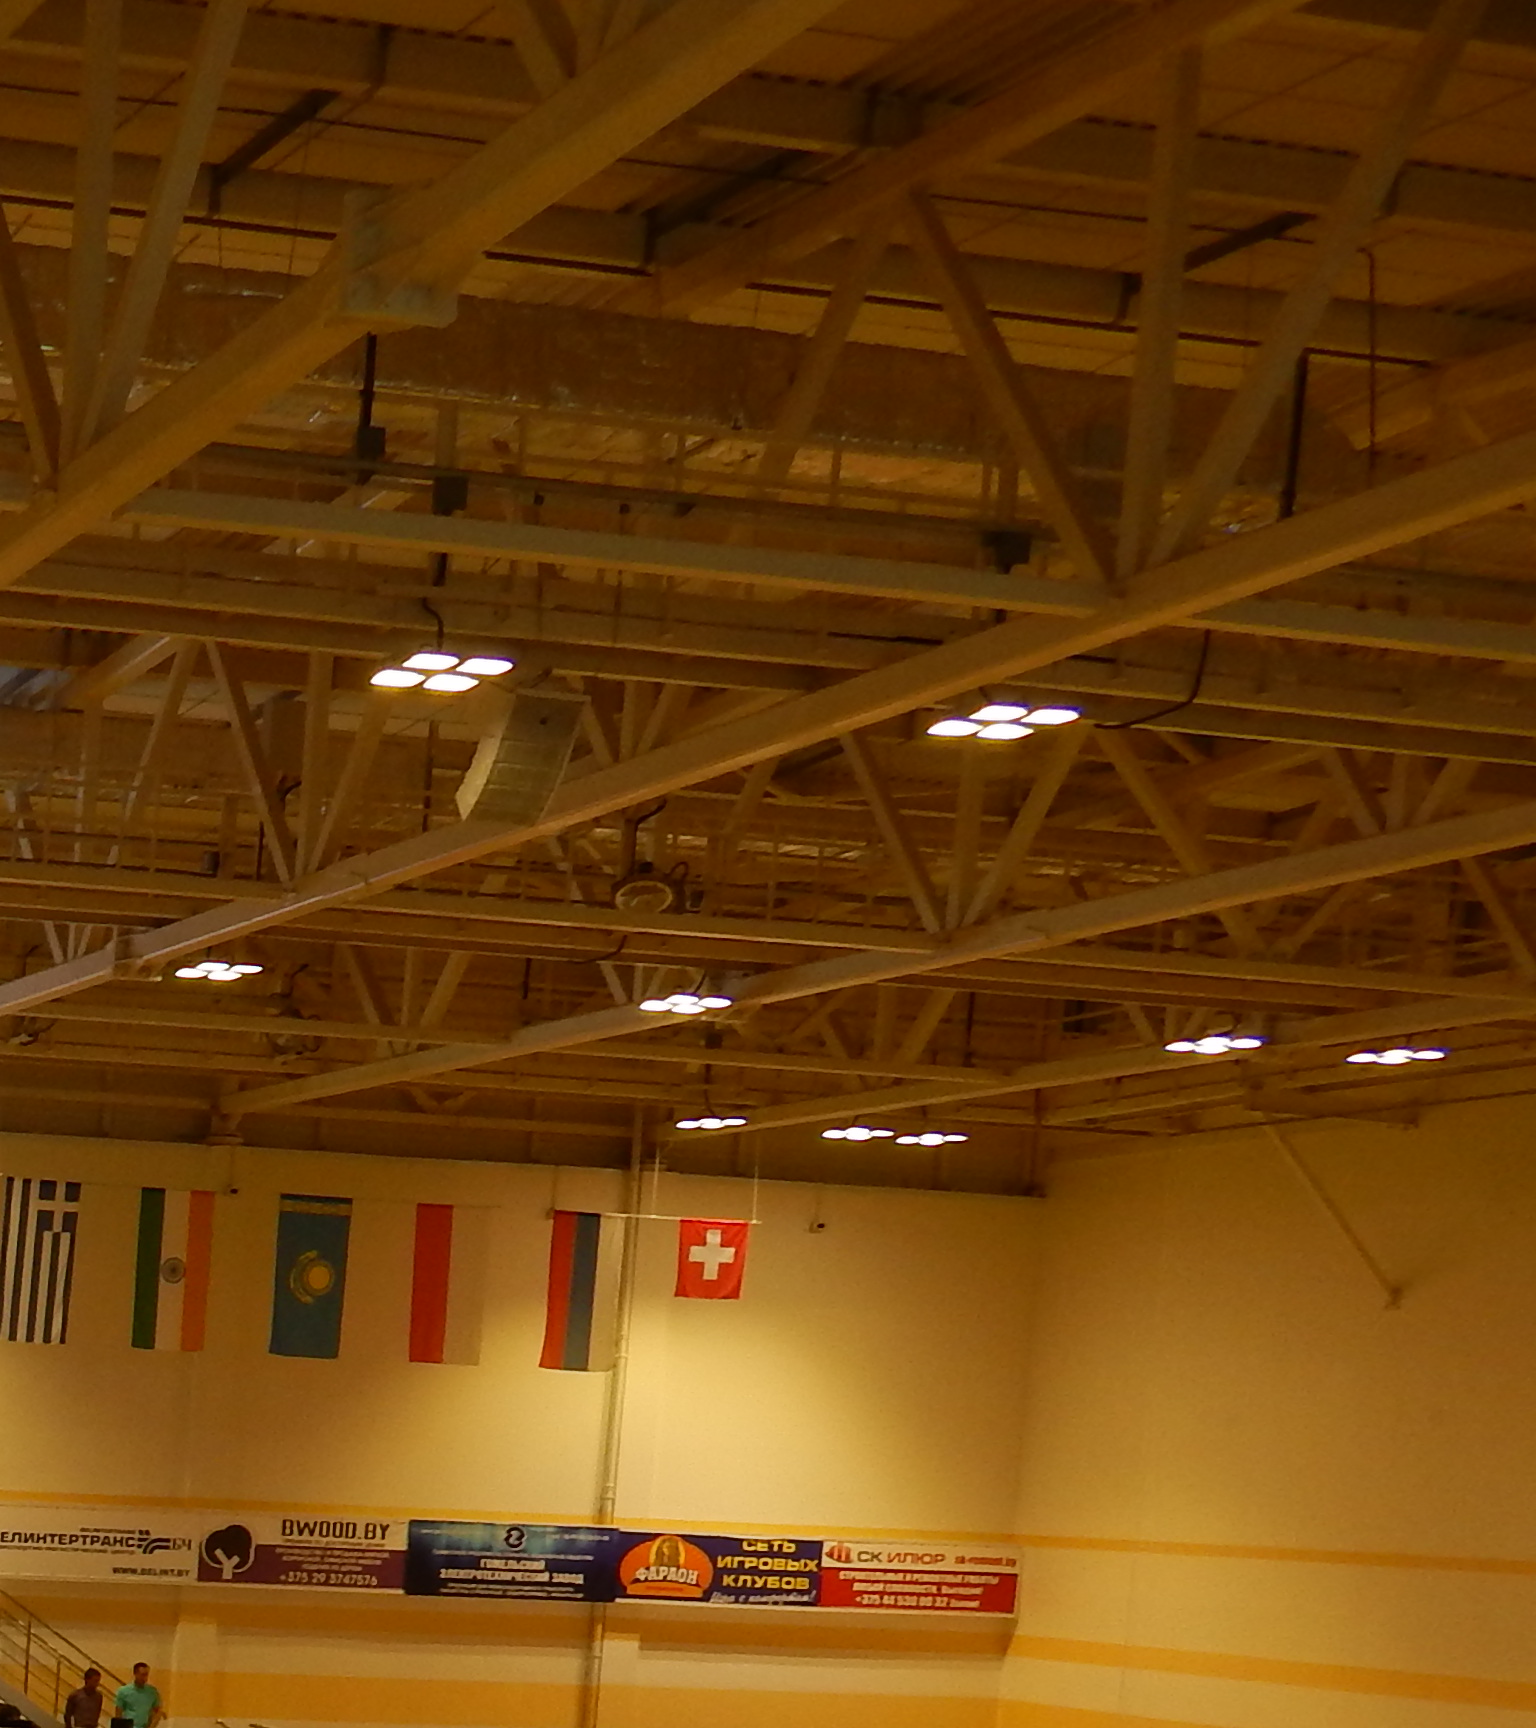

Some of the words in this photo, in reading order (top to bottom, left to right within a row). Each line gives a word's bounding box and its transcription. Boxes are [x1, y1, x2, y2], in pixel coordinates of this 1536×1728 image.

[281, 1519, 390, 1540] BWOOD.BY
[742, 1540, 796, 1553] СЕТЬ
[717, 1555, 819, 1572] ИГРОВЫХ
[857, 1551, 883, 1563] СК
[886, 1552, 946, 1564] ИЛЮР
[311, 1572, 326, 1584] 29
[635, 1566, 699, 1585] ФАРАОН
[722, 1573, 810, 1590] КЛУБОВ
